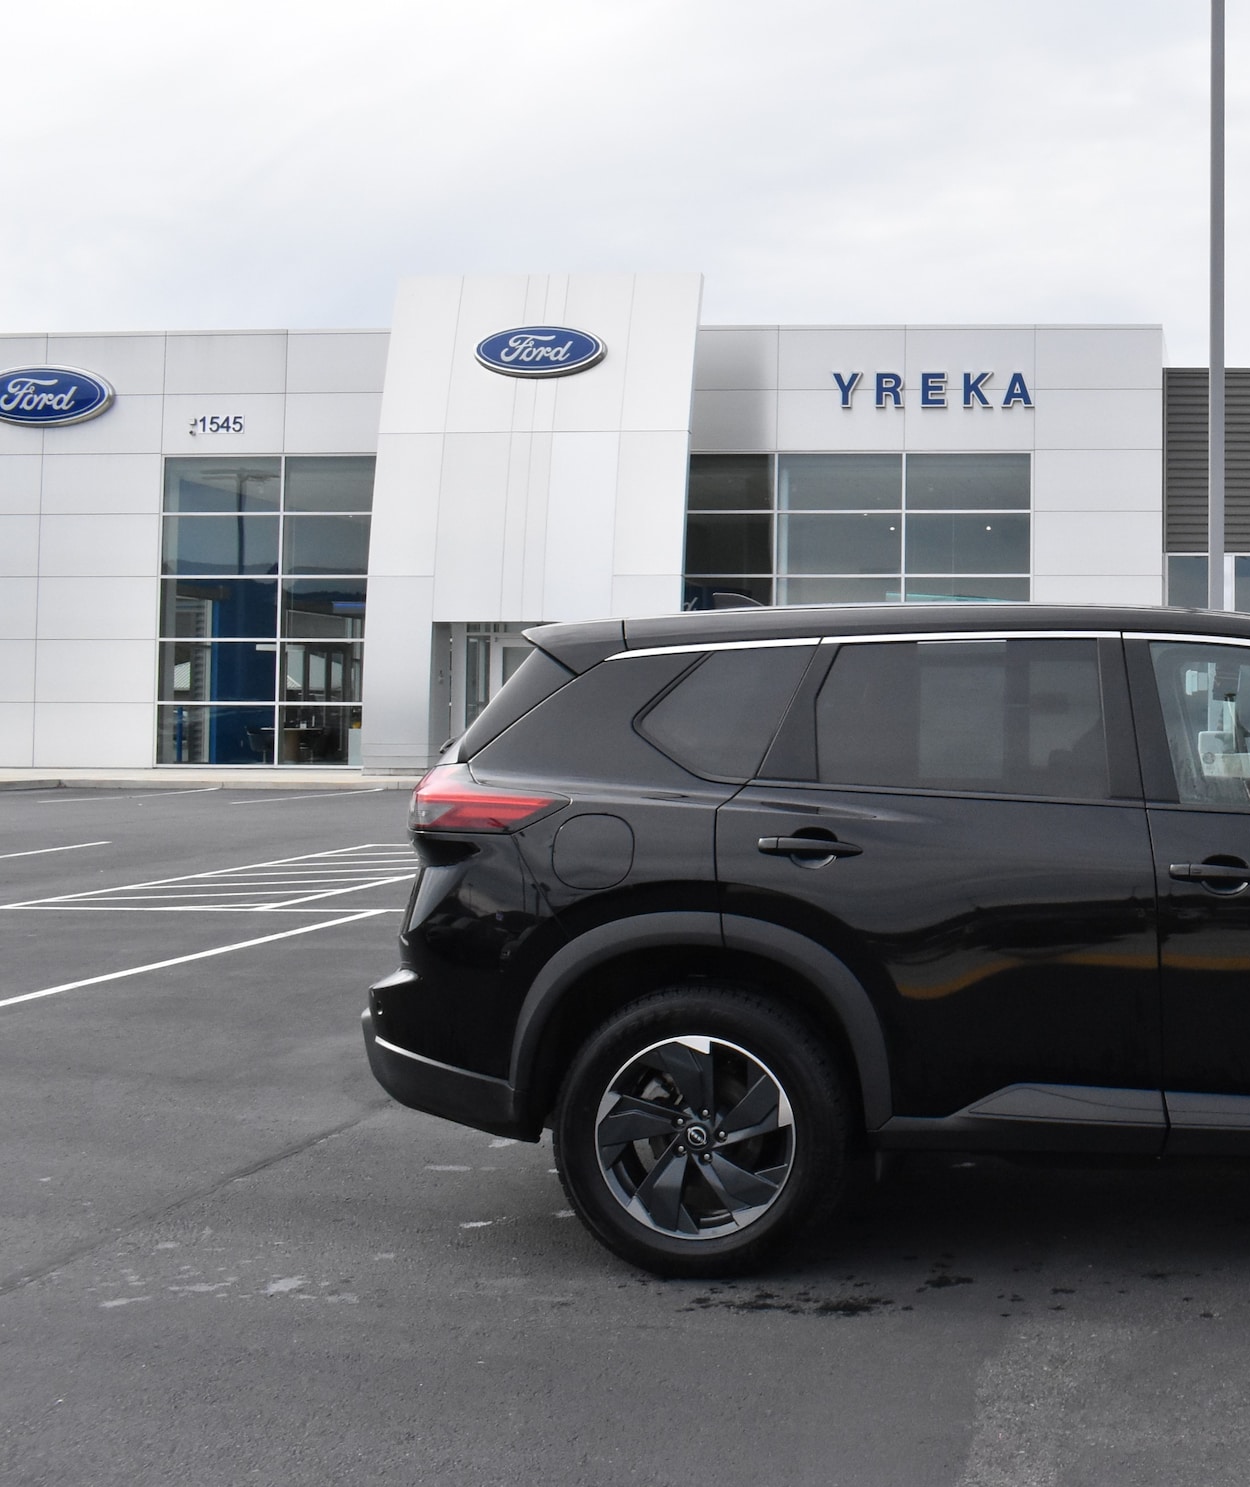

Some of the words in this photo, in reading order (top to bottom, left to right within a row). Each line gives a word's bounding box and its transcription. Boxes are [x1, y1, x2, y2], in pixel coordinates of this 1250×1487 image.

[500, 334, 573, 362] Ford
[0, 377, 78, 411] Ford
[832, 371, 1035, 408] YREKA
[199, 415, 243, 433] 1545
